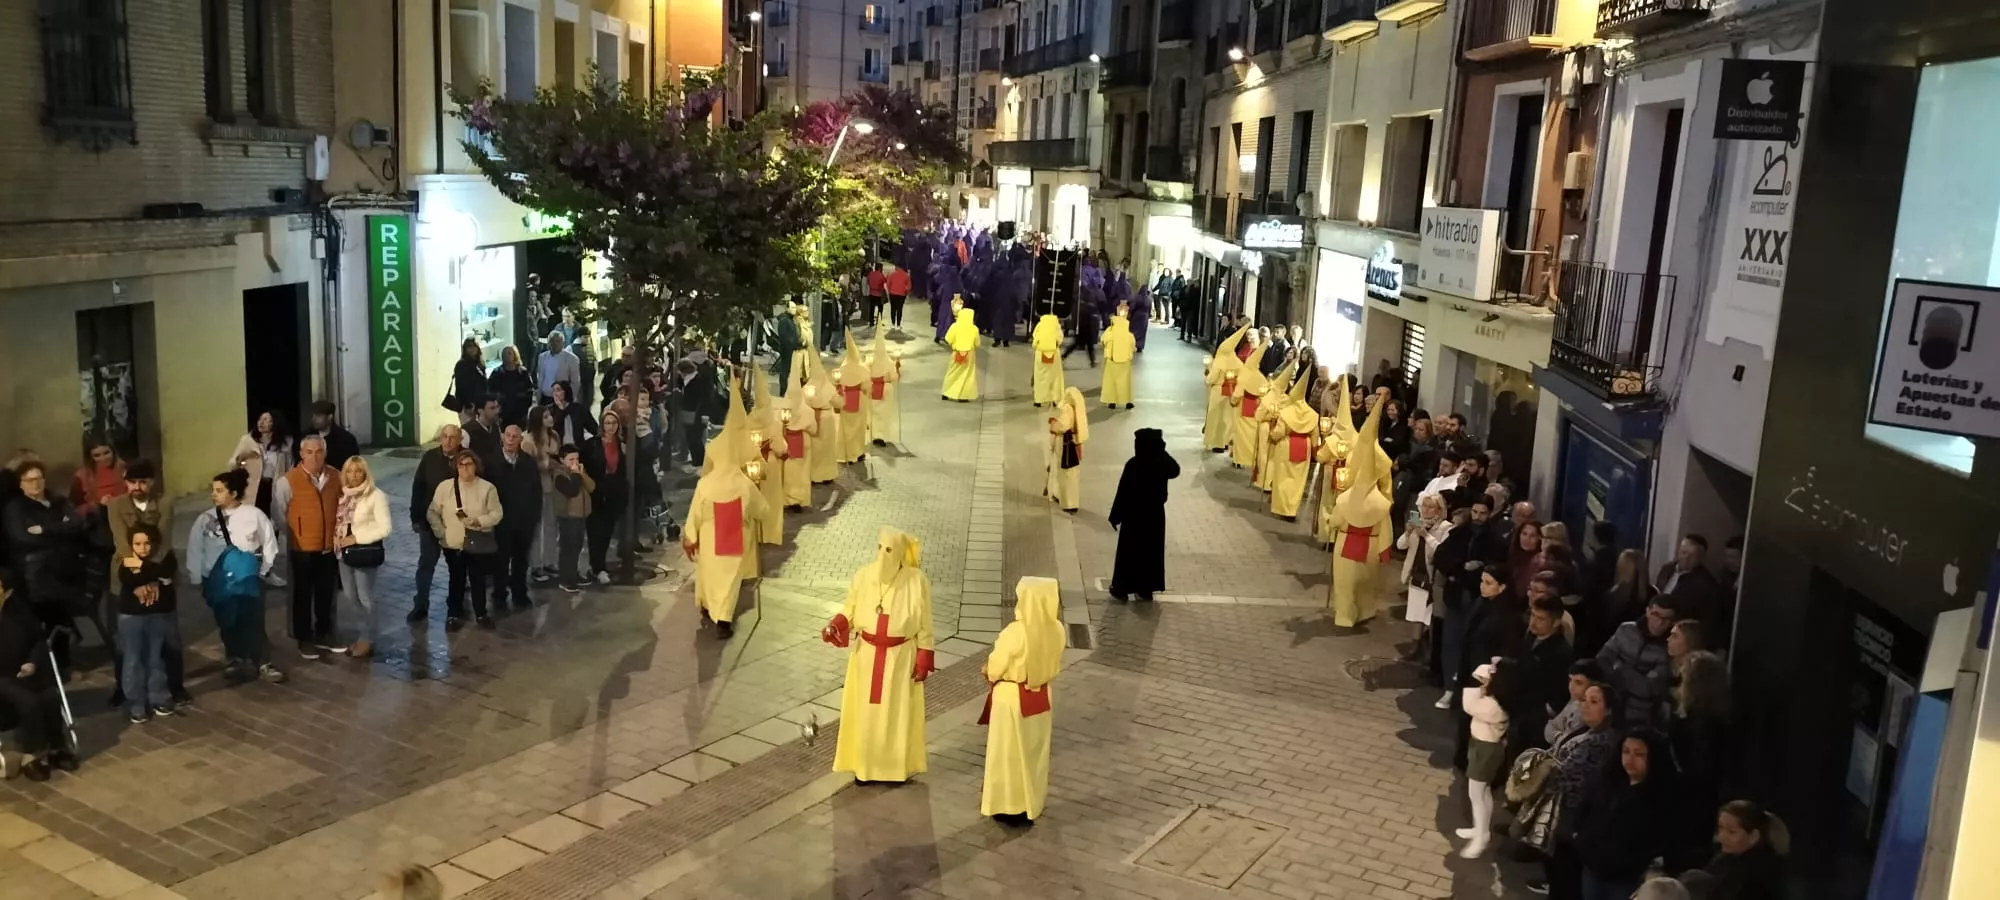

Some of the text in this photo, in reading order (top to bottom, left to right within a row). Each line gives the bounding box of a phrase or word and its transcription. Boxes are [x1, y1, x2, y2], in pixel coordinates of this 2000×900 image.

[1727, 106, 1789, 120] Distribuidor
[1726, 123, 1783, 134] autorizado
[1434, 214, 1479, 245] hitradio
[1740, 227, 1789, 266] XXX
[380, 223, 404, 439] REPARACION
[1902, 369, 1984, 395] Loterías y
[1895, 401, 1952, 421] Estado
[1899, 386, 2000, 411] Apuestas de
